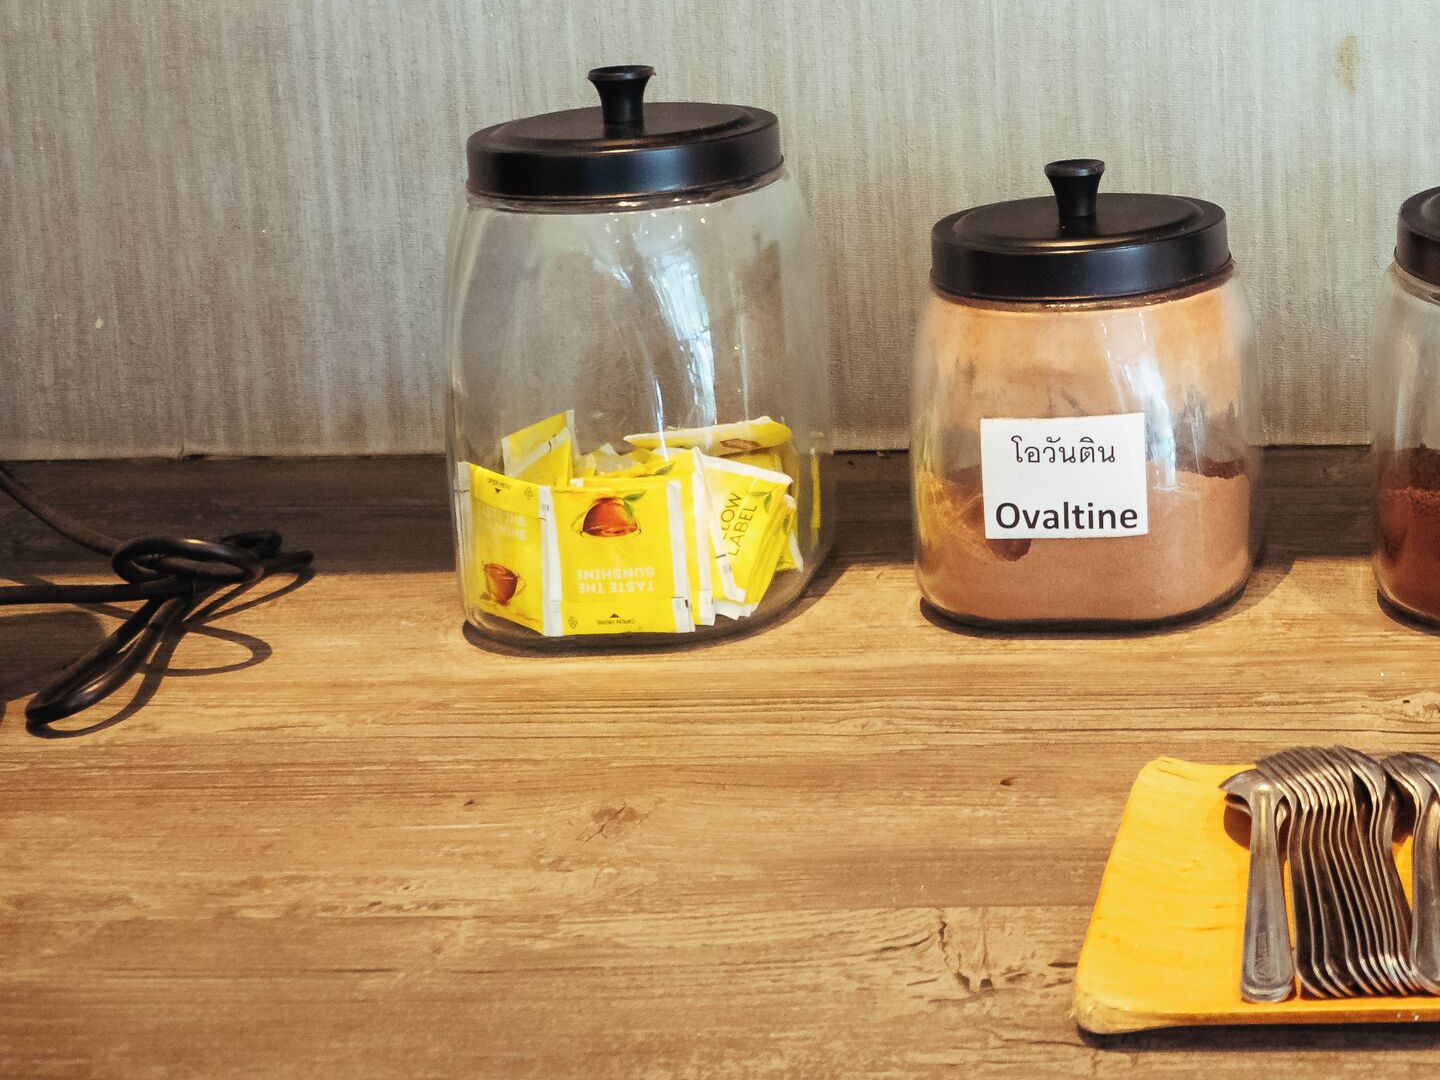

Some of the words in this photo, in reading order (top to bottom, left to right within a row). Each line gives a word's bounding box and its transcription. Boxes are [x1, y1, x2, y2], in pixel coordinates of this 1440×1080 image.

[1011, 435, 1117, 463] โอวันติน
[995, 501, 1139, 530] Ovaltine
[727, 505, 757, 557] LABEL
[576, 566, 655, 581] SUNSHINE
[578, 581, 604, 595] THE
[609, 580, 655, 594] TASTE
